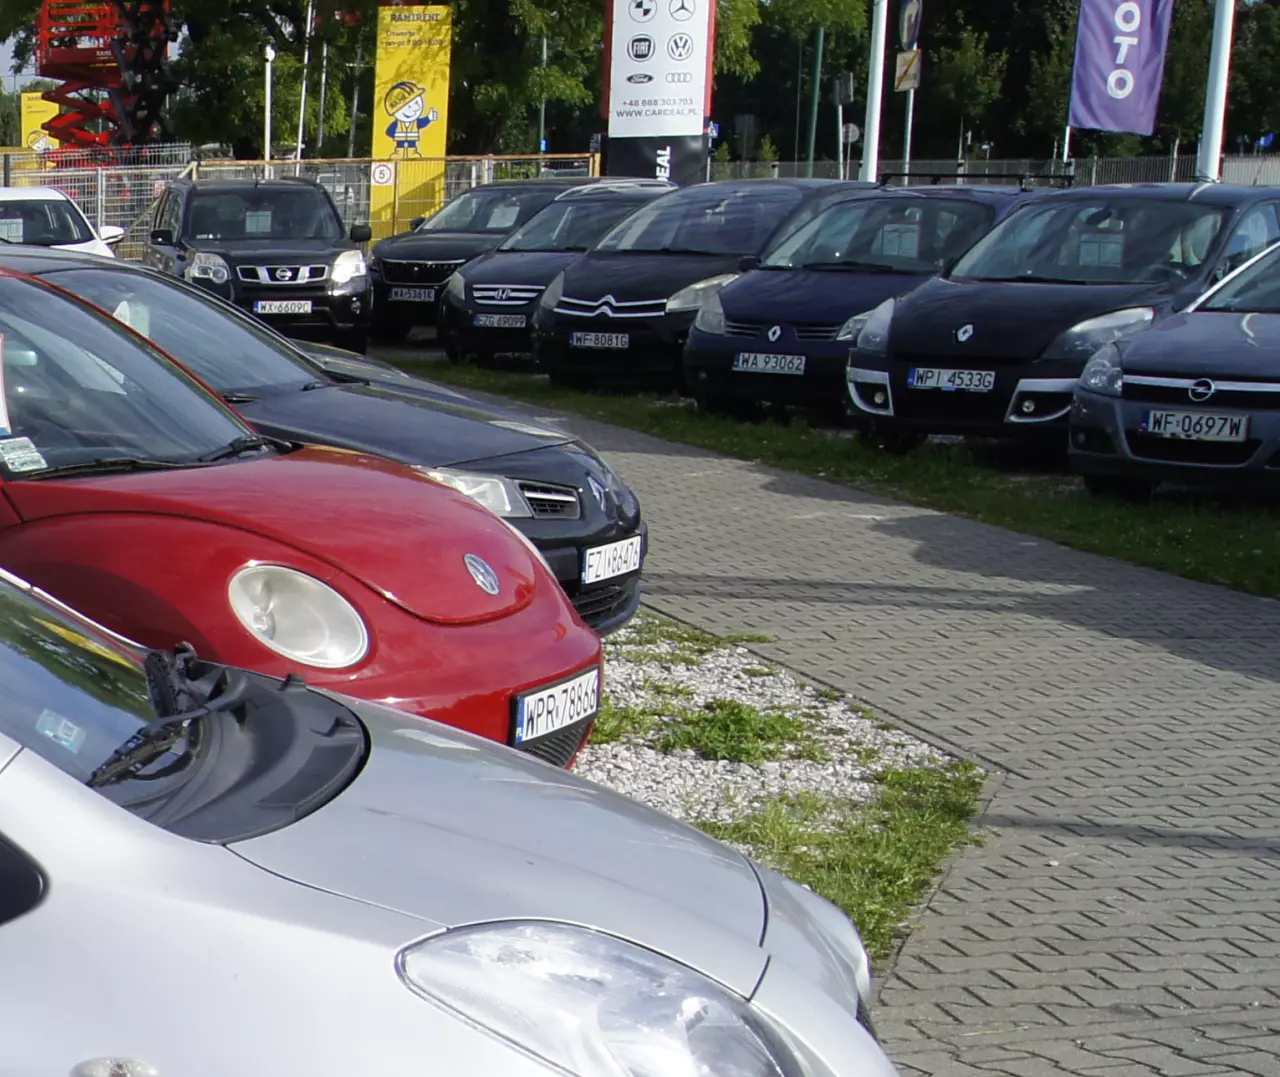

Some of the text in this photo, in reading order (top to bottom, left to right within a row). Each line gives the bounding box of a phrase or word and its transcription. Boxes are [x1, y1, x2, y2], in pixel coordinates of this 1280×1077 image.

[378, 169, 386, 180] 5
[260, 302, 274, 313] WX
[575, 333, 592, 346] WF
[741, 354, 803, 371] WA 93062
[916, 369, 994, 389] WPI 4533G
[1152, 413, 1243, 437] WF 0697W
[525, 674, 598, 738] WPR 78866
